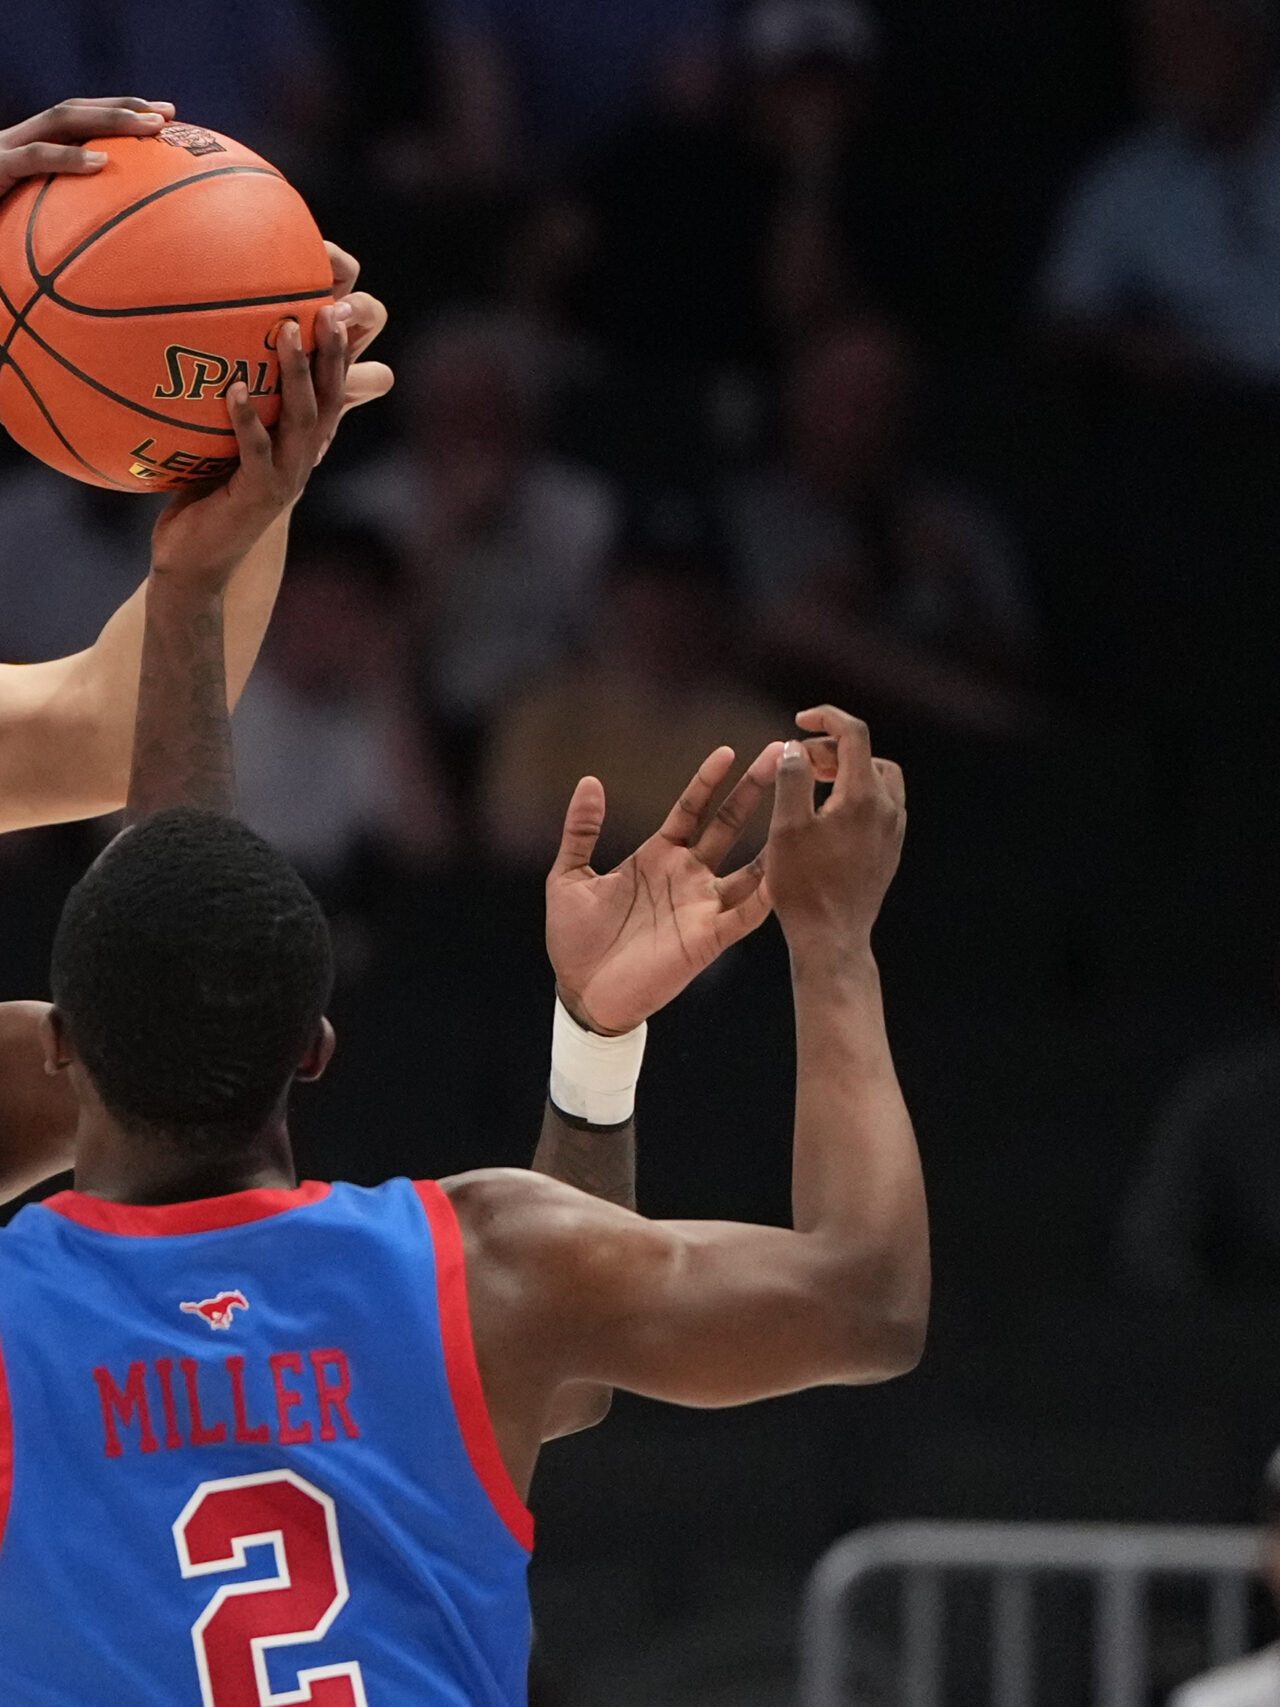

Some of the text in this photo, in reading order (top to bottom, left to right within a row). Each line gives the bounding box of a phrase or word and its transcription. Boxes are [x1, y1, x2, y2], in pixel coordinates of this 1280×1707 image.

[153, 343, 283, 399] SPAL
[93, 1348, 360, 1457] MILLER
[172, 1469, 368, 1707] 2
